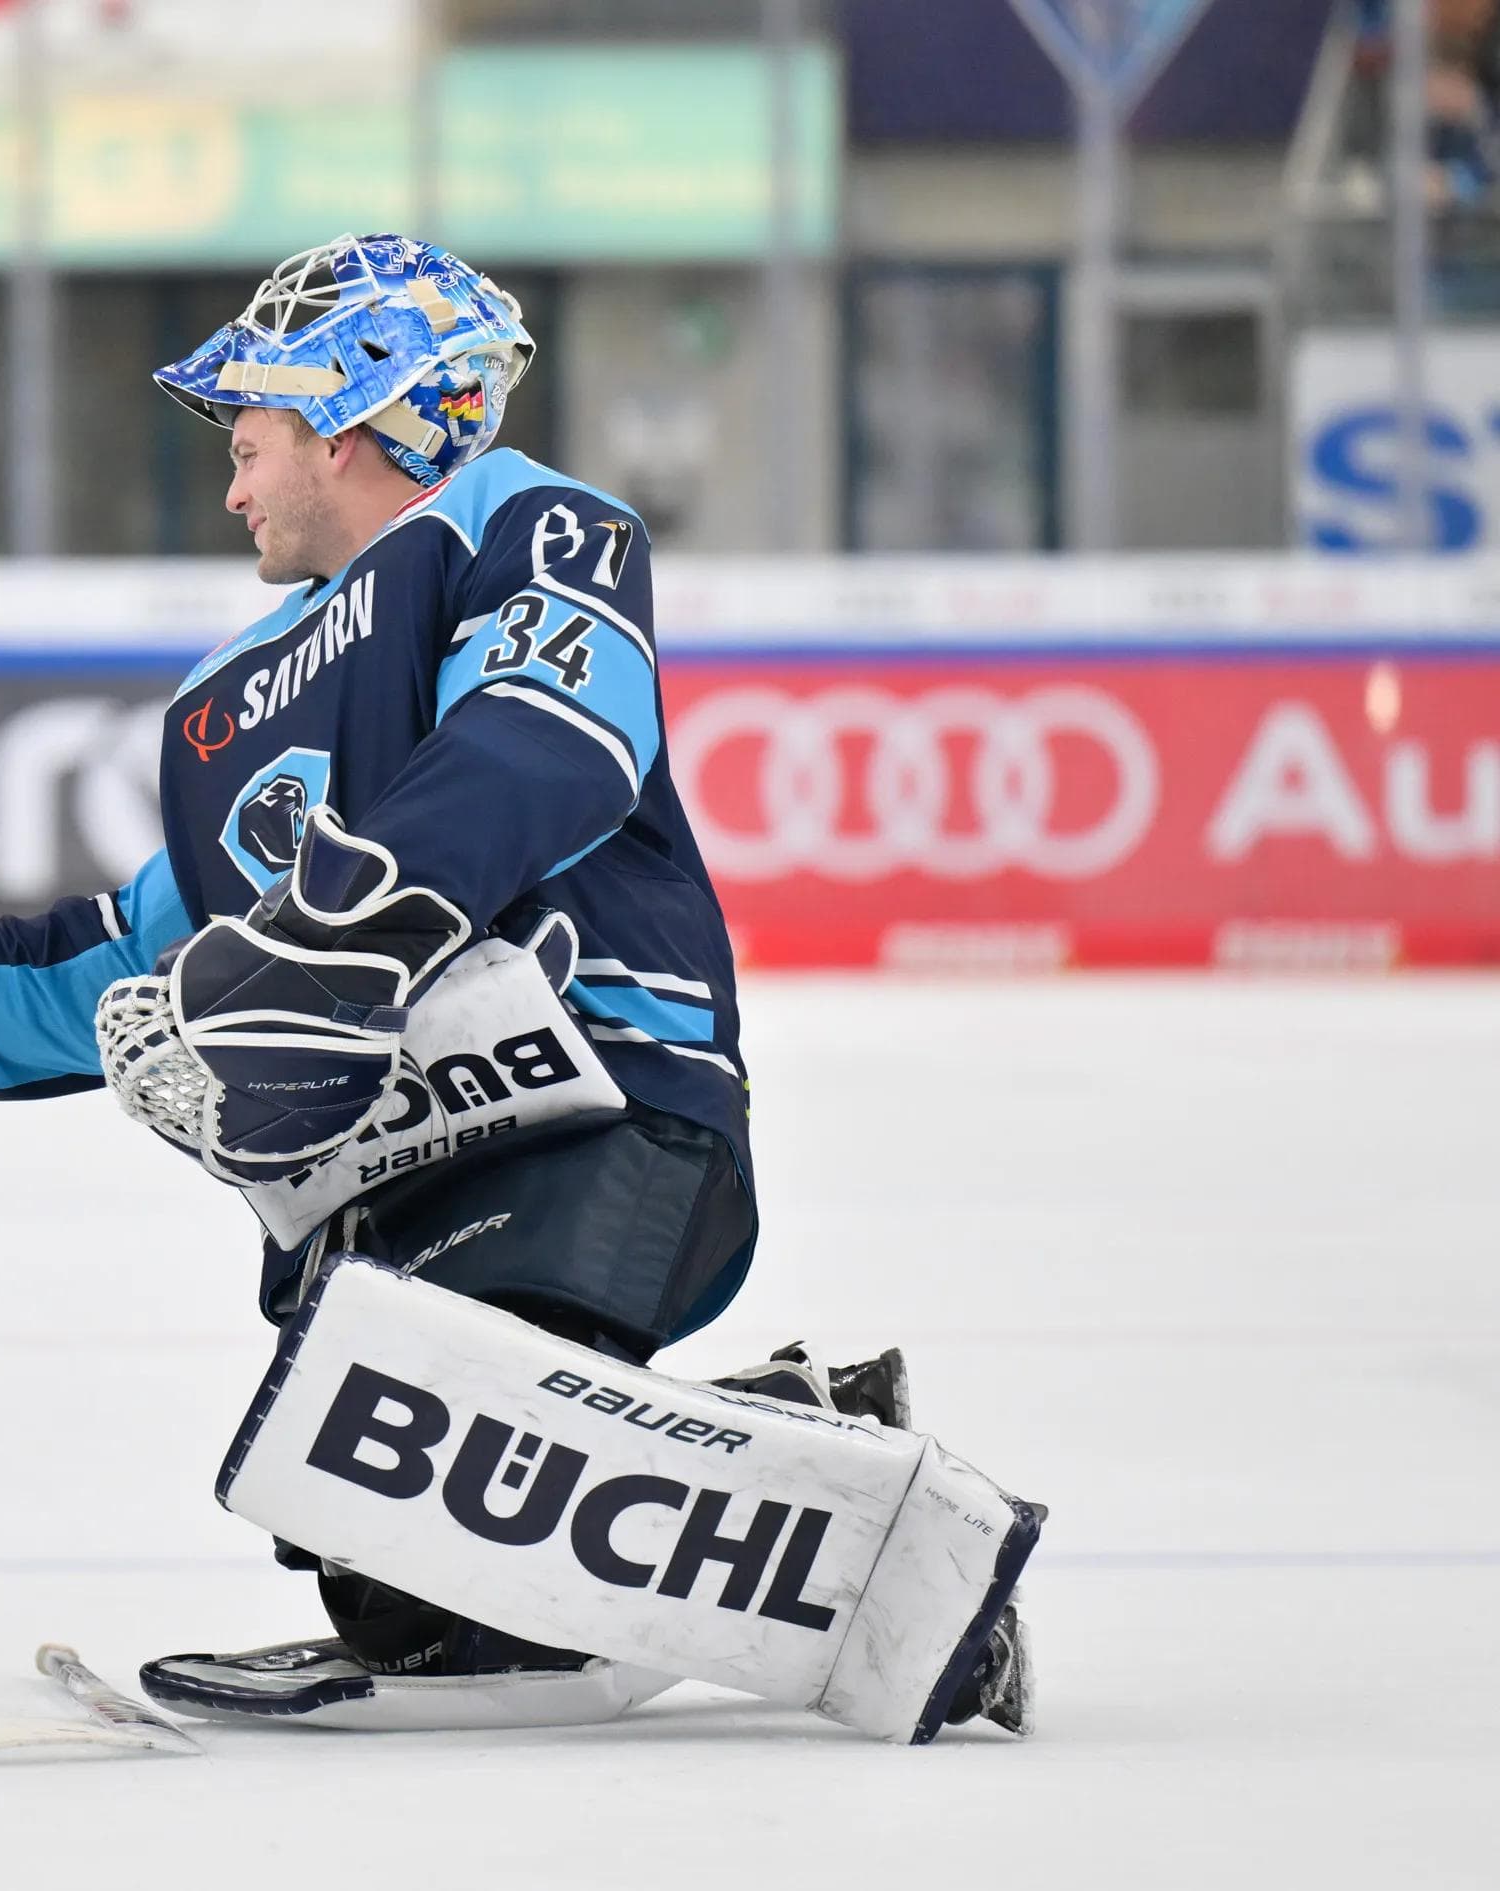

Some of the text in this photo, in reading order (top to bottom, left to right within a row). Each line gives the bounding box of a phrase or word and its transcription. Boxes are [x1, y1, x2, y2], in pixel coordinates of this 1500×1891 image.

[1308, 400, 1500, 556] S
[238, 570, 376, 730] SATURN
[480, 591, 598, 695] 34
[247, 1075, 351, 1091] HYPERLITE
[305, 1362, 838, 1632] BÜCHL
[356, 1641, 444, 1674] AUER
